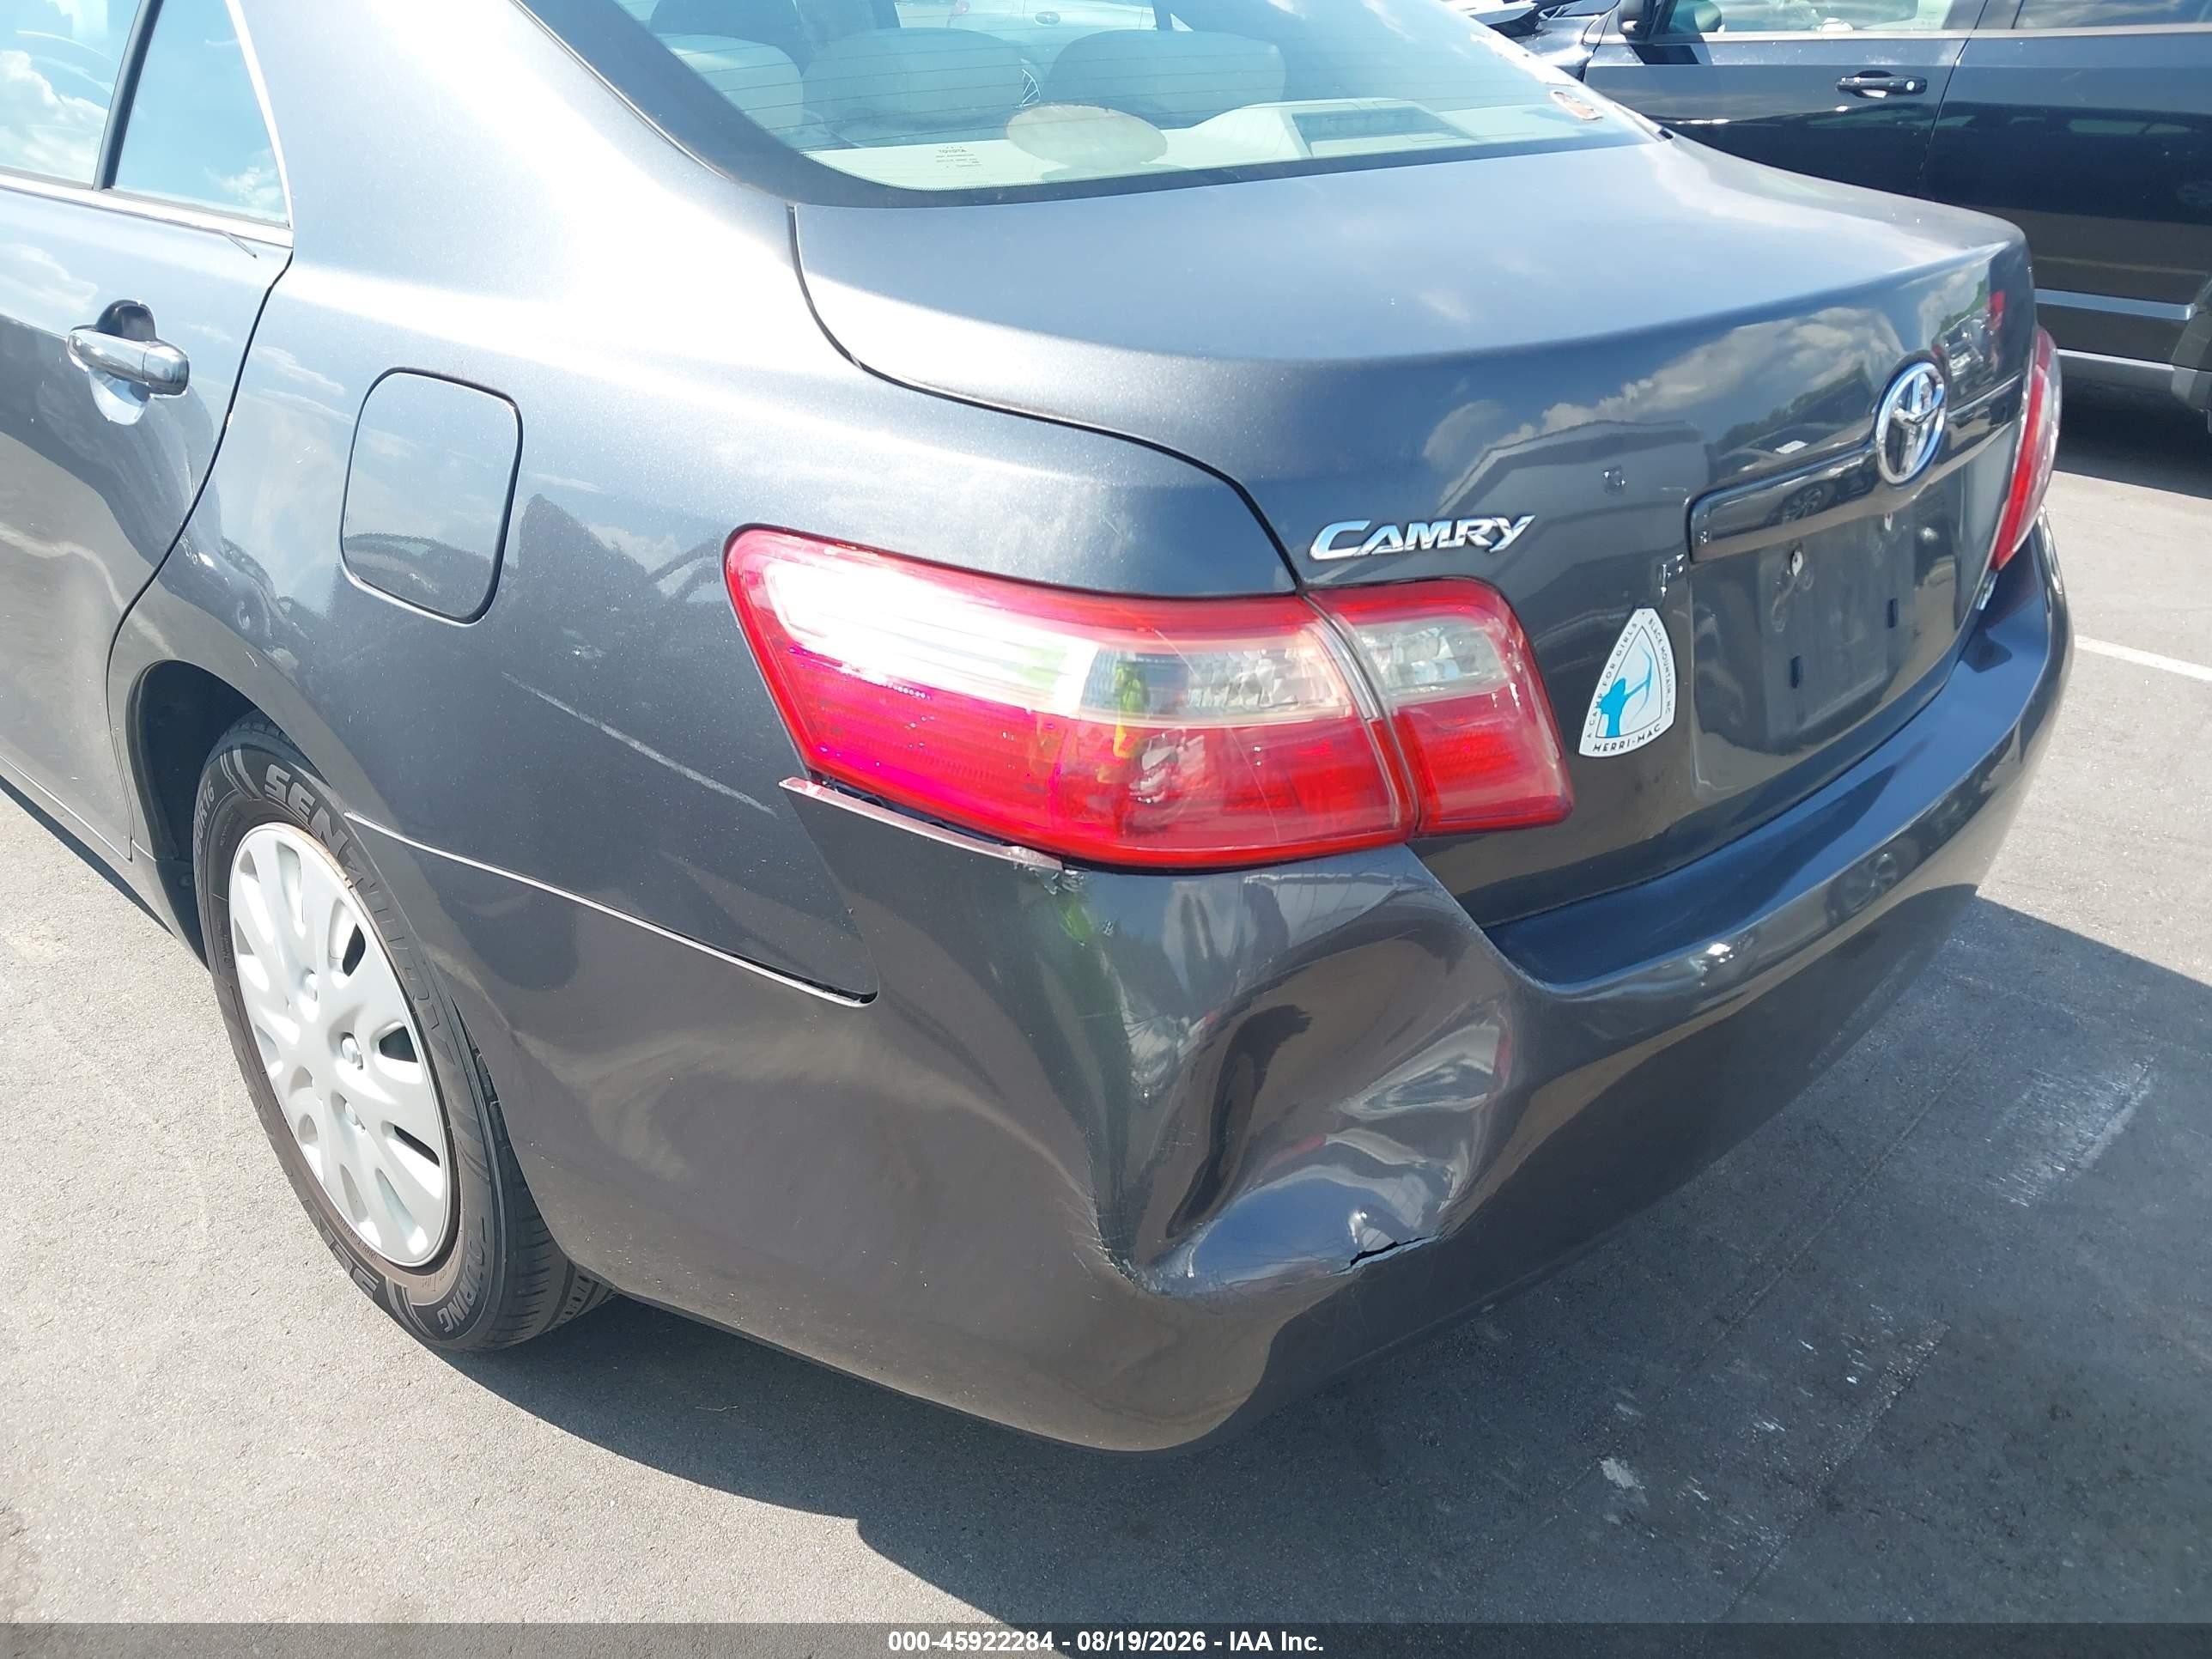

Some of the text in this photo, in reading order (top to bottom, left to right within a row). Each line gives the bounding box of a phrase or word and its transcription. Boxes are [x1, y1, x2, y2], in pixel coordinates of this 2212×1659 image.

[1310, 514, 1537, 561] CAMRY
[1648, 617, 1663, 644] BLACK
[1601, 662, 1616, 687] FOR
[1616, 623, 1637, 656] GIRLS
[1592, 723, 1662, 752] MERRI-MAC
[436, 1216, 487, 1333] TOURING
